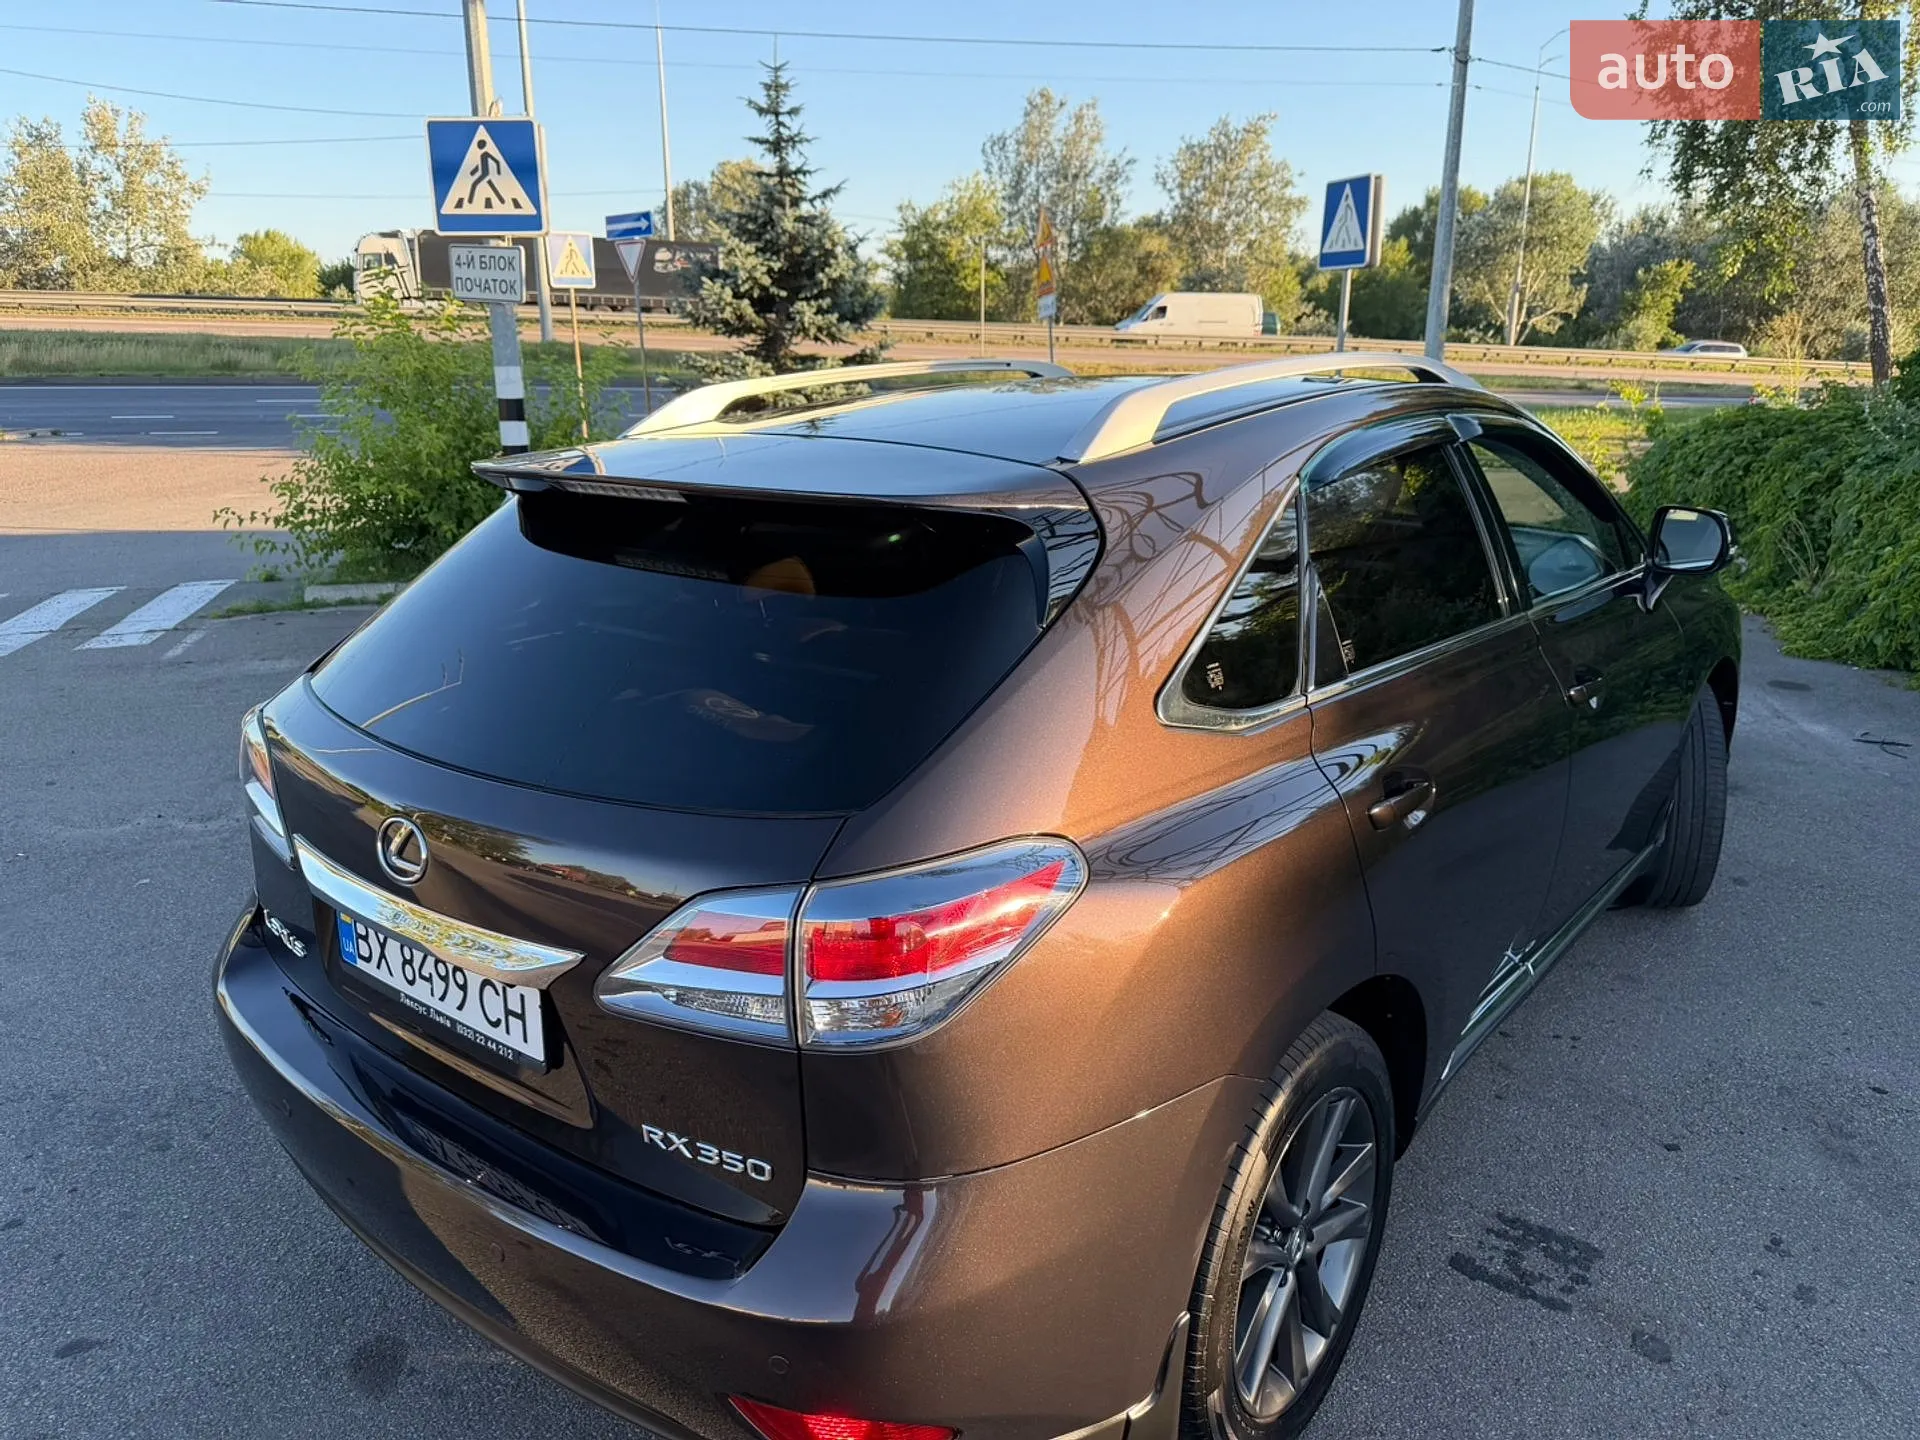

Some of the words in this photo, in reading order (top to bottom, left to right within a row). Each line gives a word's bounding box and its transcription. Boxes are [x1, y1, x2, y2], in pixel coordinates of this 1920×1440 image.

[455, 250, 476, 270] 4-Й
[479, 254, 517, 272] БЛОК
[455, 276, 518, 296] ПОЧАТОК
[344, 936, 355, 955] UA
[354, 920, 394, 978] BX
[401, 945, 469, 1012] 8499
[479, 978, 528, 1044] CH
[476, 1034, 486, 1046] 22
[487, 1041, 497, 1052] 44
[499, 1046, 513, 1061] 212
